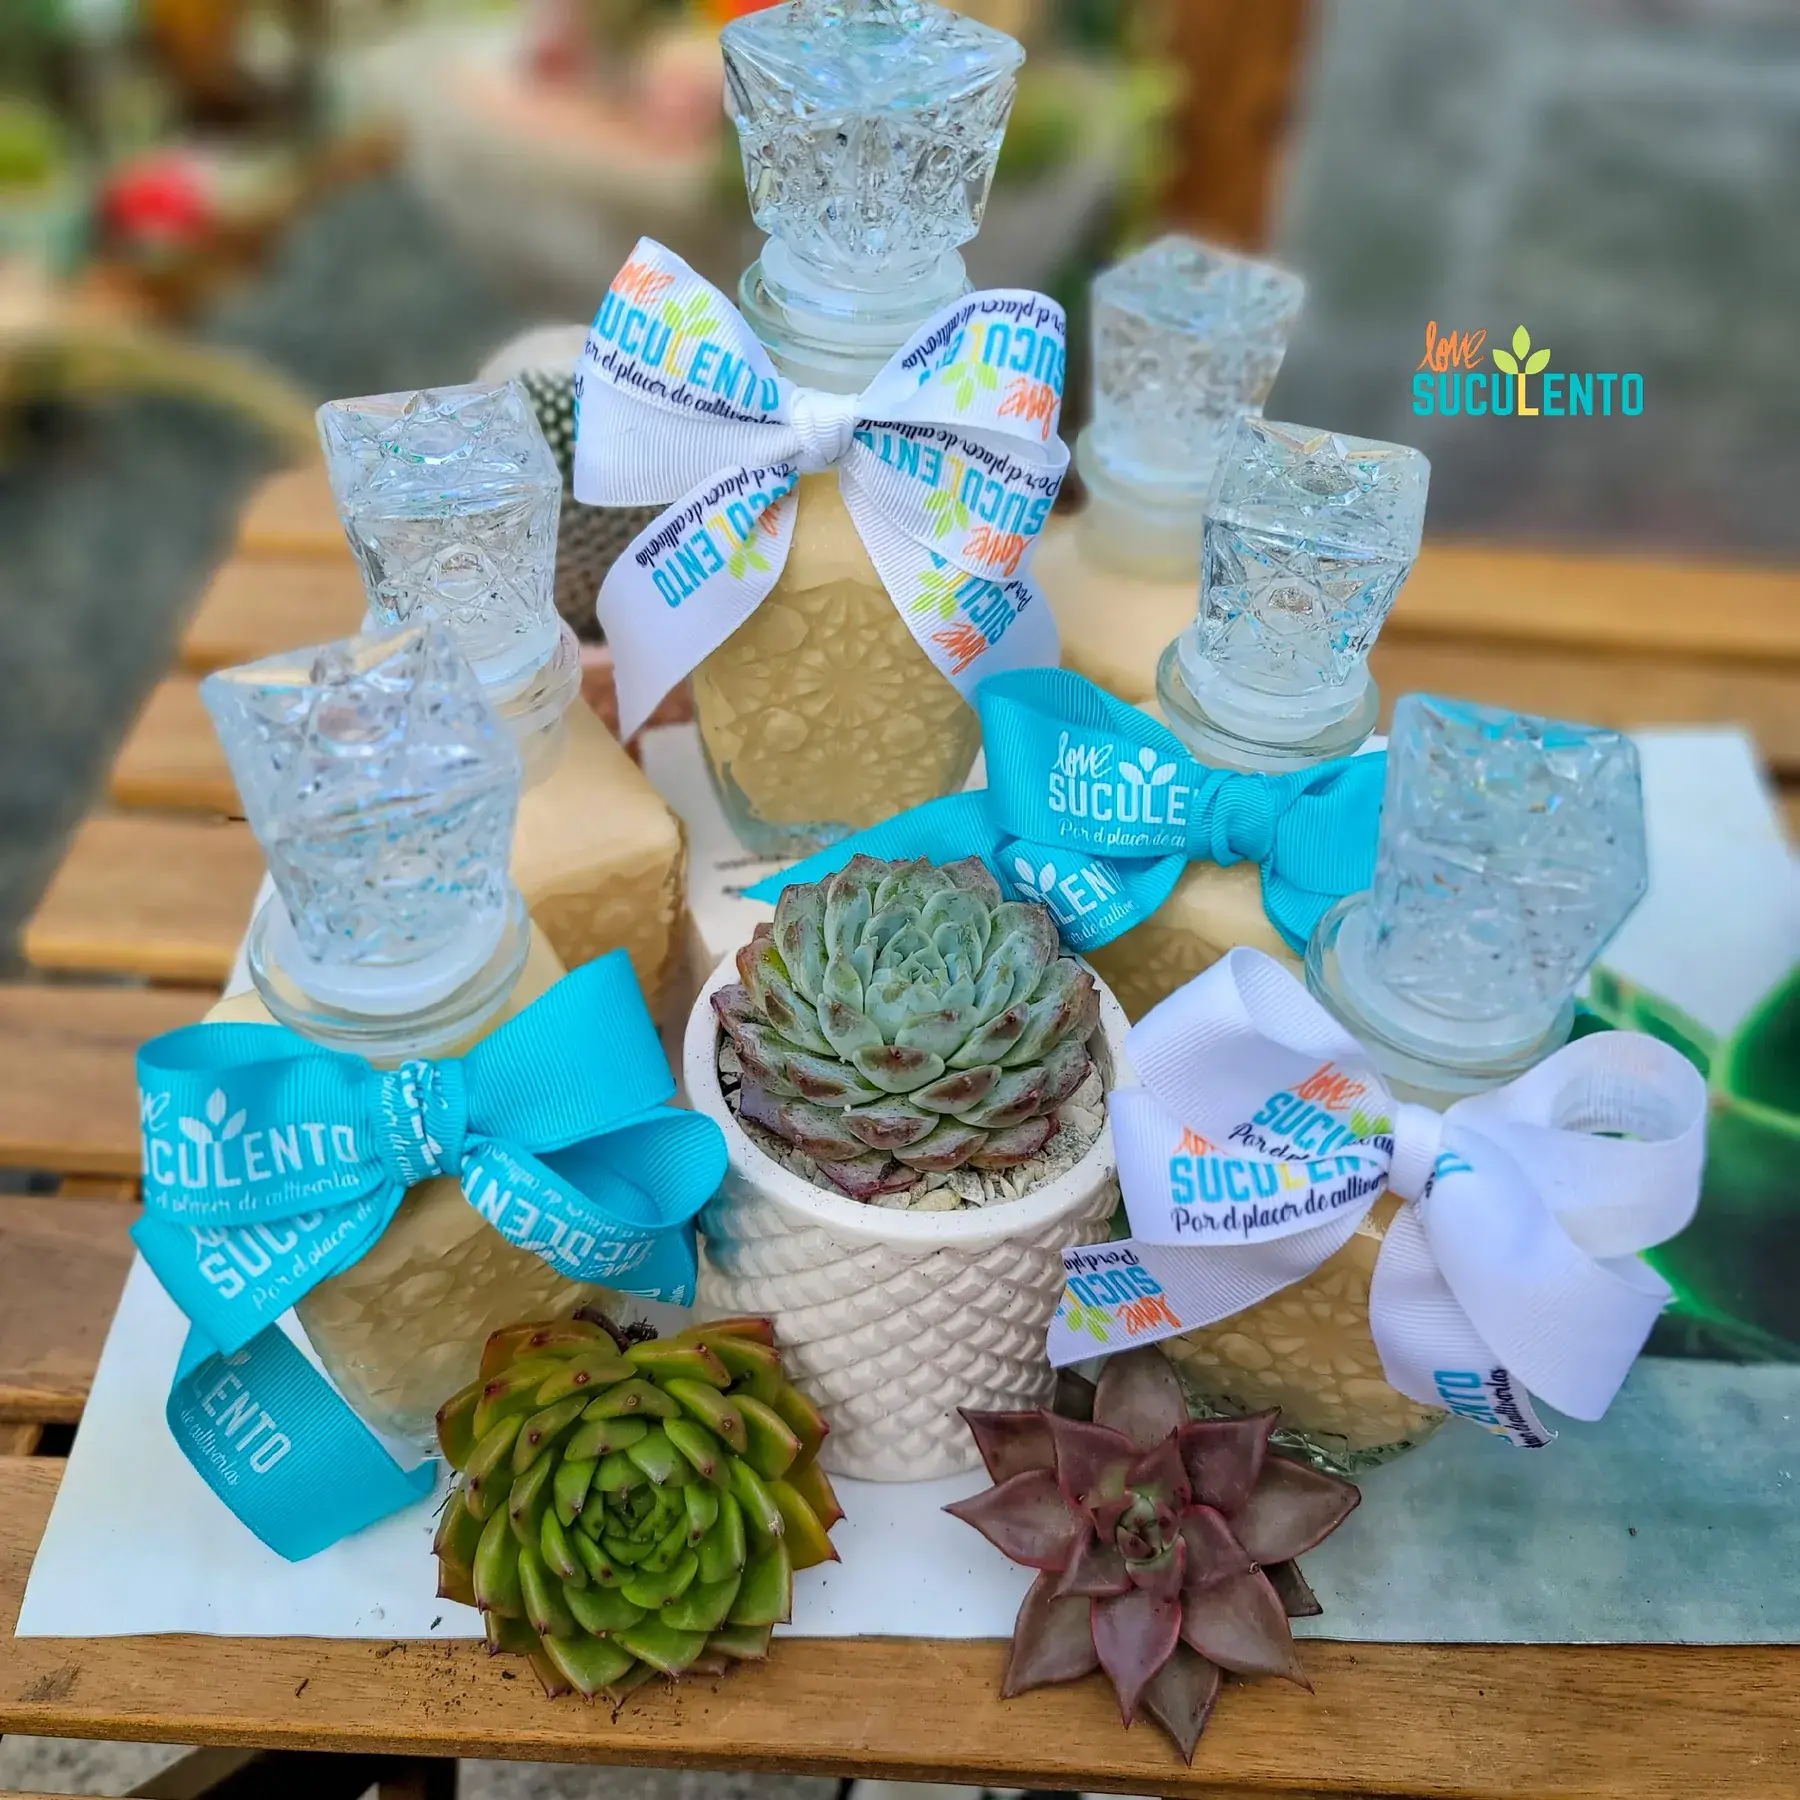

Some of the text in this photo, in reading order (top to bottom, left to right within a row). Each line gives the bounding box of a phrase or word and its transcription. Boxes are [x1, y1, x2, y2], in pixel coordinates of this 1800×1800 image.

[980, 295, 1037, 324] placer
[613, 357, 670, 398] placer
[670, 387, 693, 408] de
[997, 377, 1060, 443] love
[938, 430, 961, 451] de
[963, 443, 1008, 475] placer
[704, 466, 750, 507] placer
[1028, 473, 1062, 497] Por
[962, 524, 1036, 577] love
[1052, 730, 1114, 779] love
[1060, 818, 1092, 843] Por
[1107, 826, 1152, 847] placer
[1152, 828, 1170, 846] de
[1285, 1061, 1369, 1112] love
[1228, 1122, 1269, 1156] Por
[1171, 1205, 1220, 1234] Por
[1242, 1202, 1304, 1239] placer
[1304, 1188, 1329, 1216] de
[251, 1275, 294, 1310] Por
